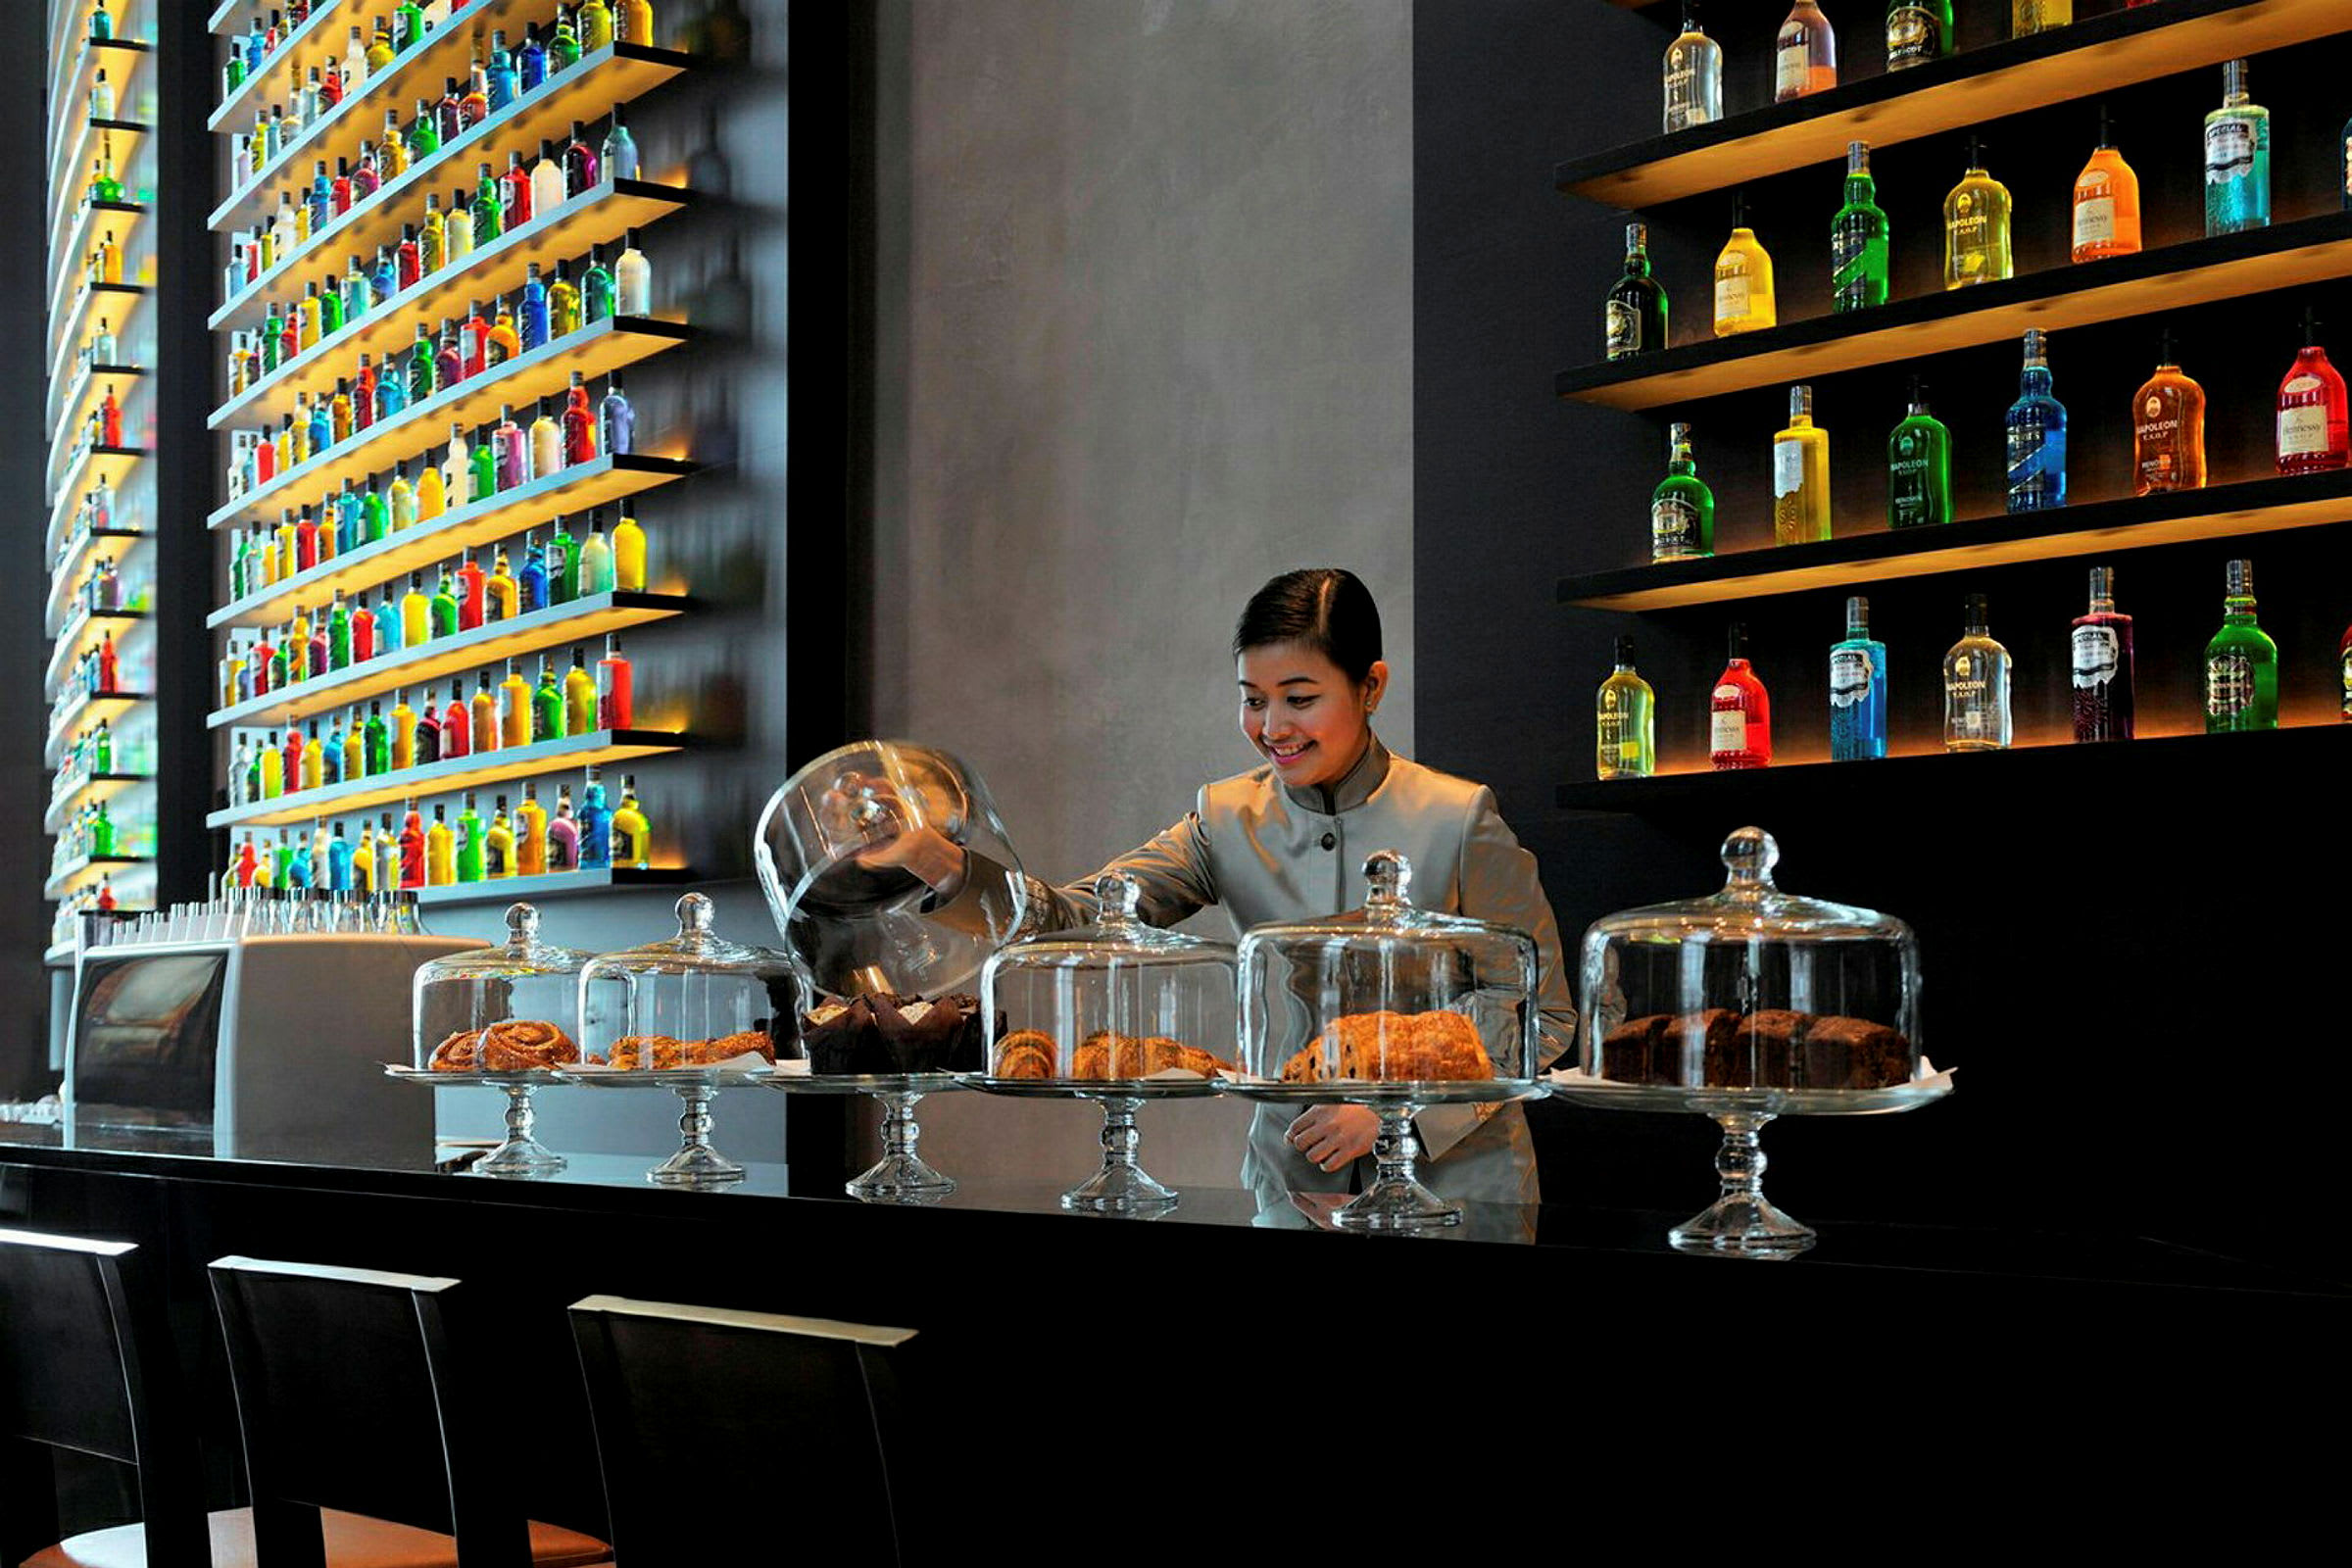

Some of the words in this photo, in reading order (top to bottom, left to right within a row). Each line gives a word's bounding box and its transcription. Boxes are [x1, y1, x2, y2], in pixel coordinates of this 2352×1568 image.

[1946, 215, 1987, 229] NAPOLEON
[2136, 419, 2178, 434] NAPOLEON
[1890, 458, 1929, 471] NAPOLEON
